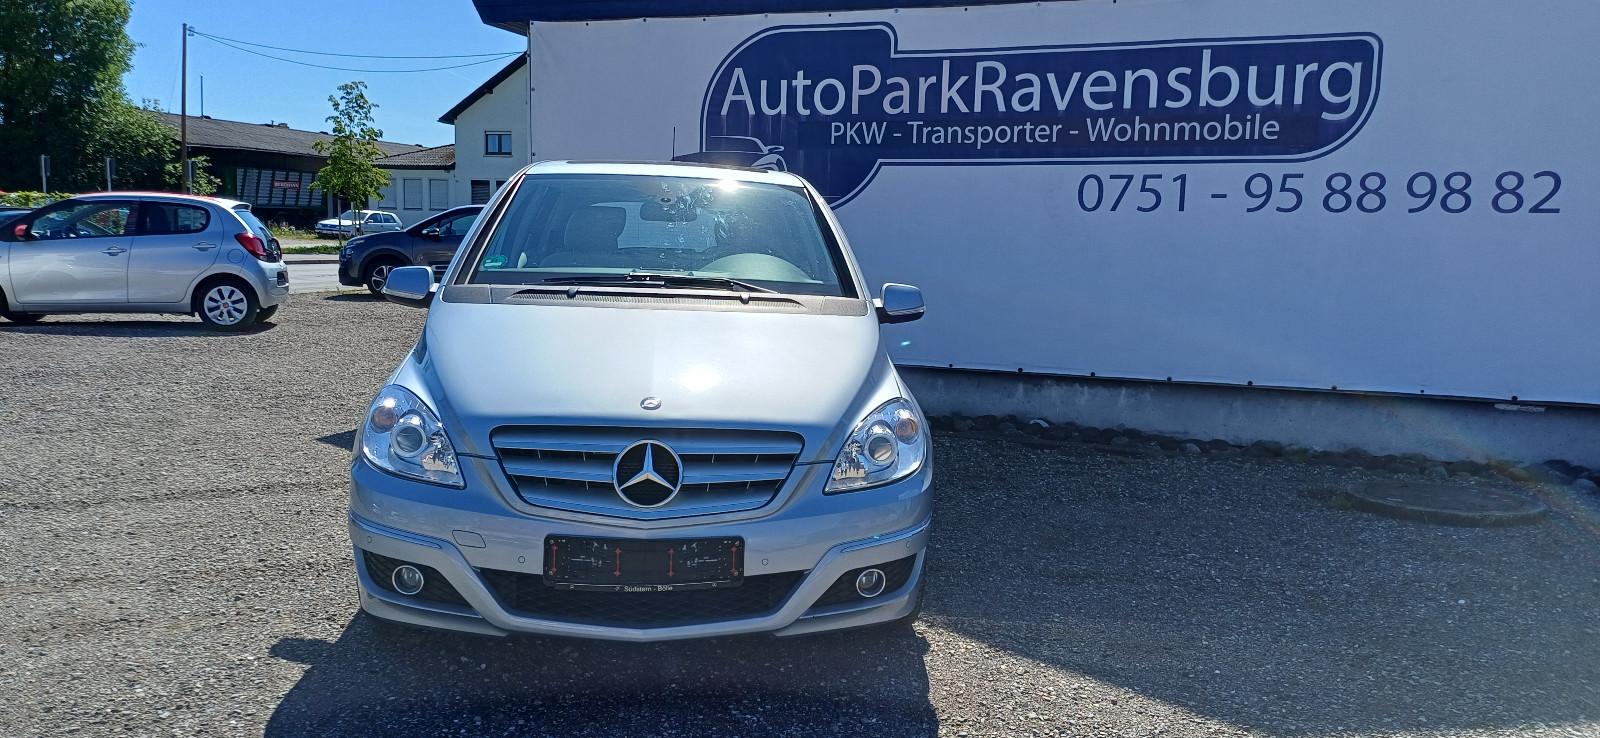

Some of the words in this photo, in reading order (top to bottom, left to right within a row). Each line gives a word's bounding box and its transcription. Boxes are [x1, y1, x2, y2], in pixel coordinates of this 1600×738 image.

[720, 49, 1363, 121] AutoParkRavensburg
[830, 121, 887, 145] PKW
[907, 120, 1062, 150] Transporter
[1086, 113, 1280, 142] Wohnmobile
[1077, 173, 1188, 213] 0751
[1244, 172, 1305, 213] 95
[1322, 172, 1387, 214] 88
[1406, 171, 1473, 214] 98
[1491, 170, 1563, 214] 82
